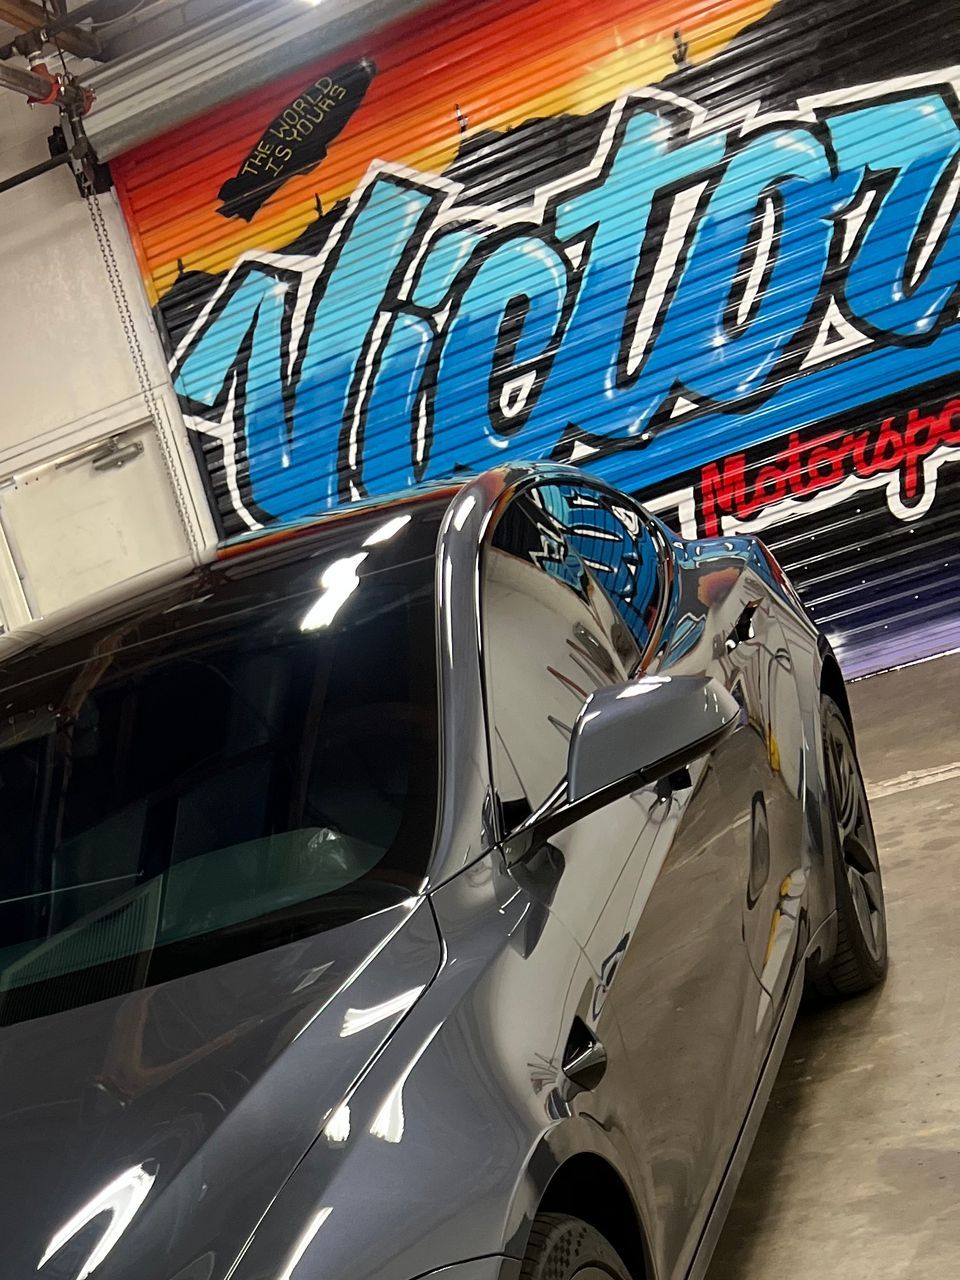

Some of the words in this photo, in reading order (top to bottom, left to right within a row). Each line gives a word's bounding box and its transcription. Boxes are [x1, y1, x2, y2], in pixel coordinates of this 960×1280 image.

[242, 140, 273, 175] THE
[270, 76, 333, 139] WORLD
[265, 145, 293, 177] IS
[286, 85, 347, 141] YOURS
